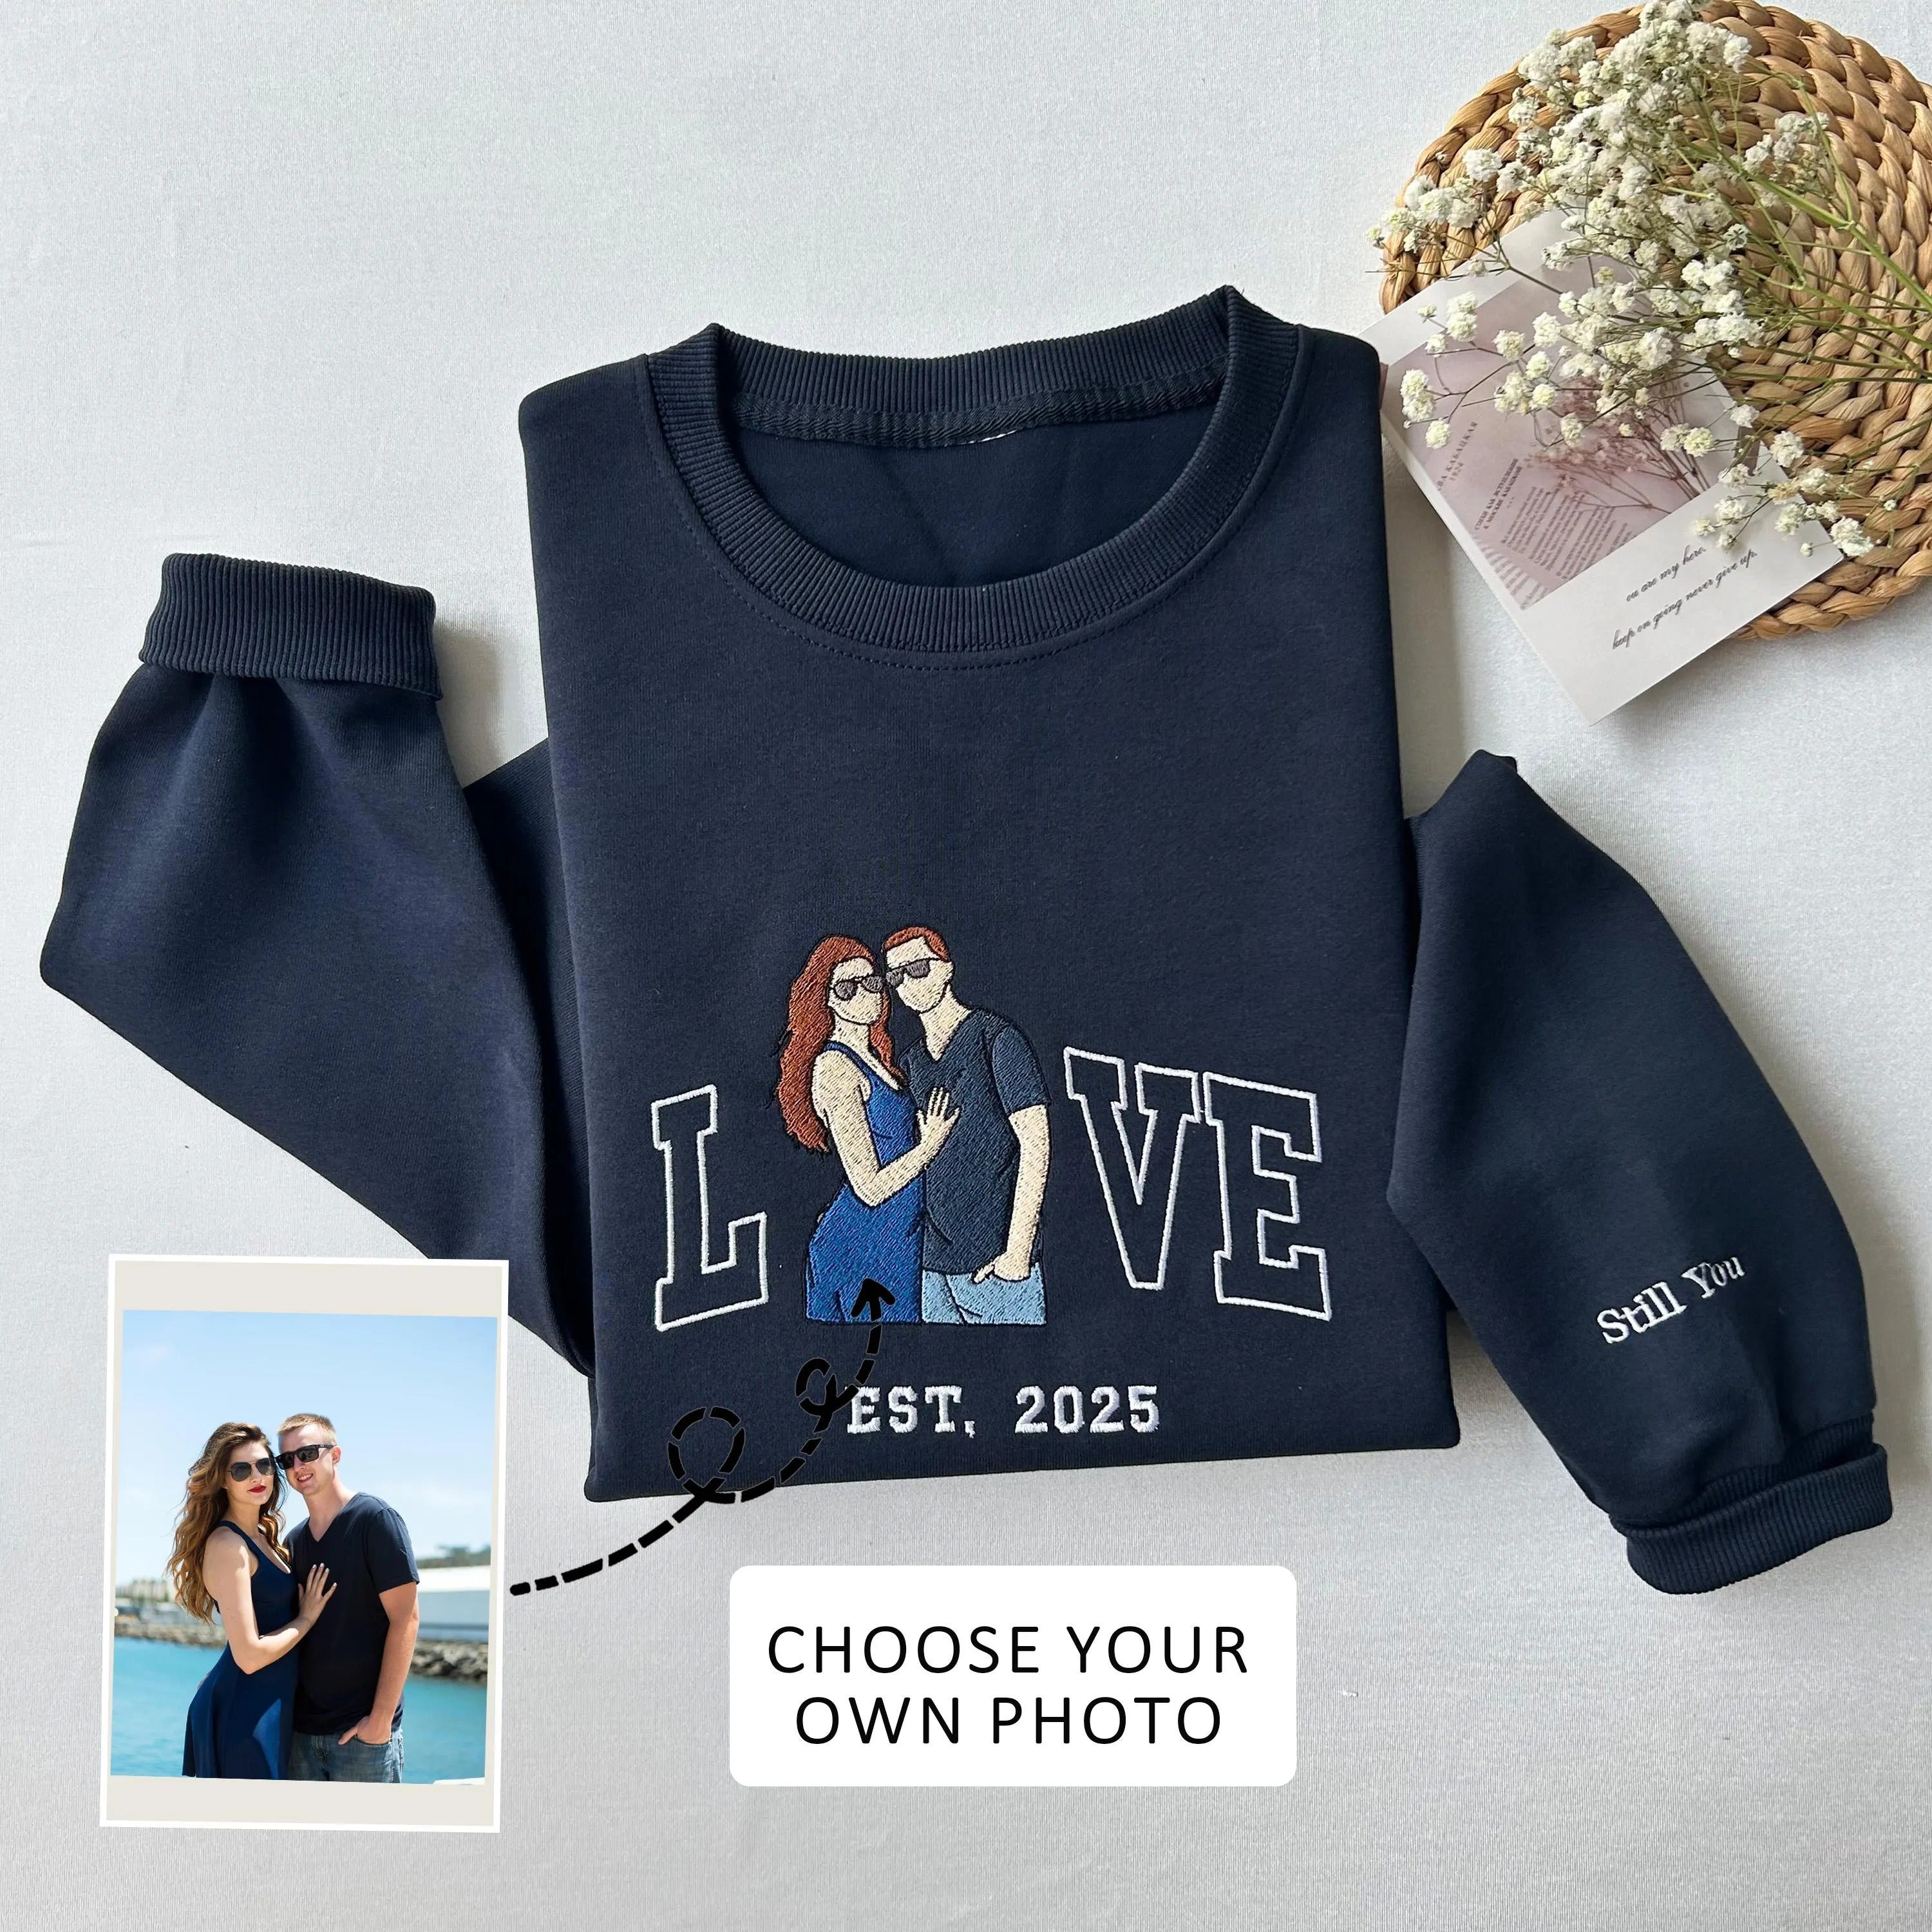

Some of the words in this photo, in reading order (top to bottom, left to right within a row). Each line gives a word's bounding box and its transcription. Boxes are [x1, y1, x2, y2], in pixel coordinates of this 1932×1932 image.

[1637, 620, 1651, 633] on
[1653, 598, 1683, 629] going
[1685, 578, 1714, 601] never
[1716, 562, 1738, 589] give
[1641, 578, 1658, 592] are
[1659, 562, 1680, 580] my
[1596, 1281, 1688, 1344] Still
[1681, 1256, 1746, 1299] You
[1015, 1385, 1159, 1434] 2025
